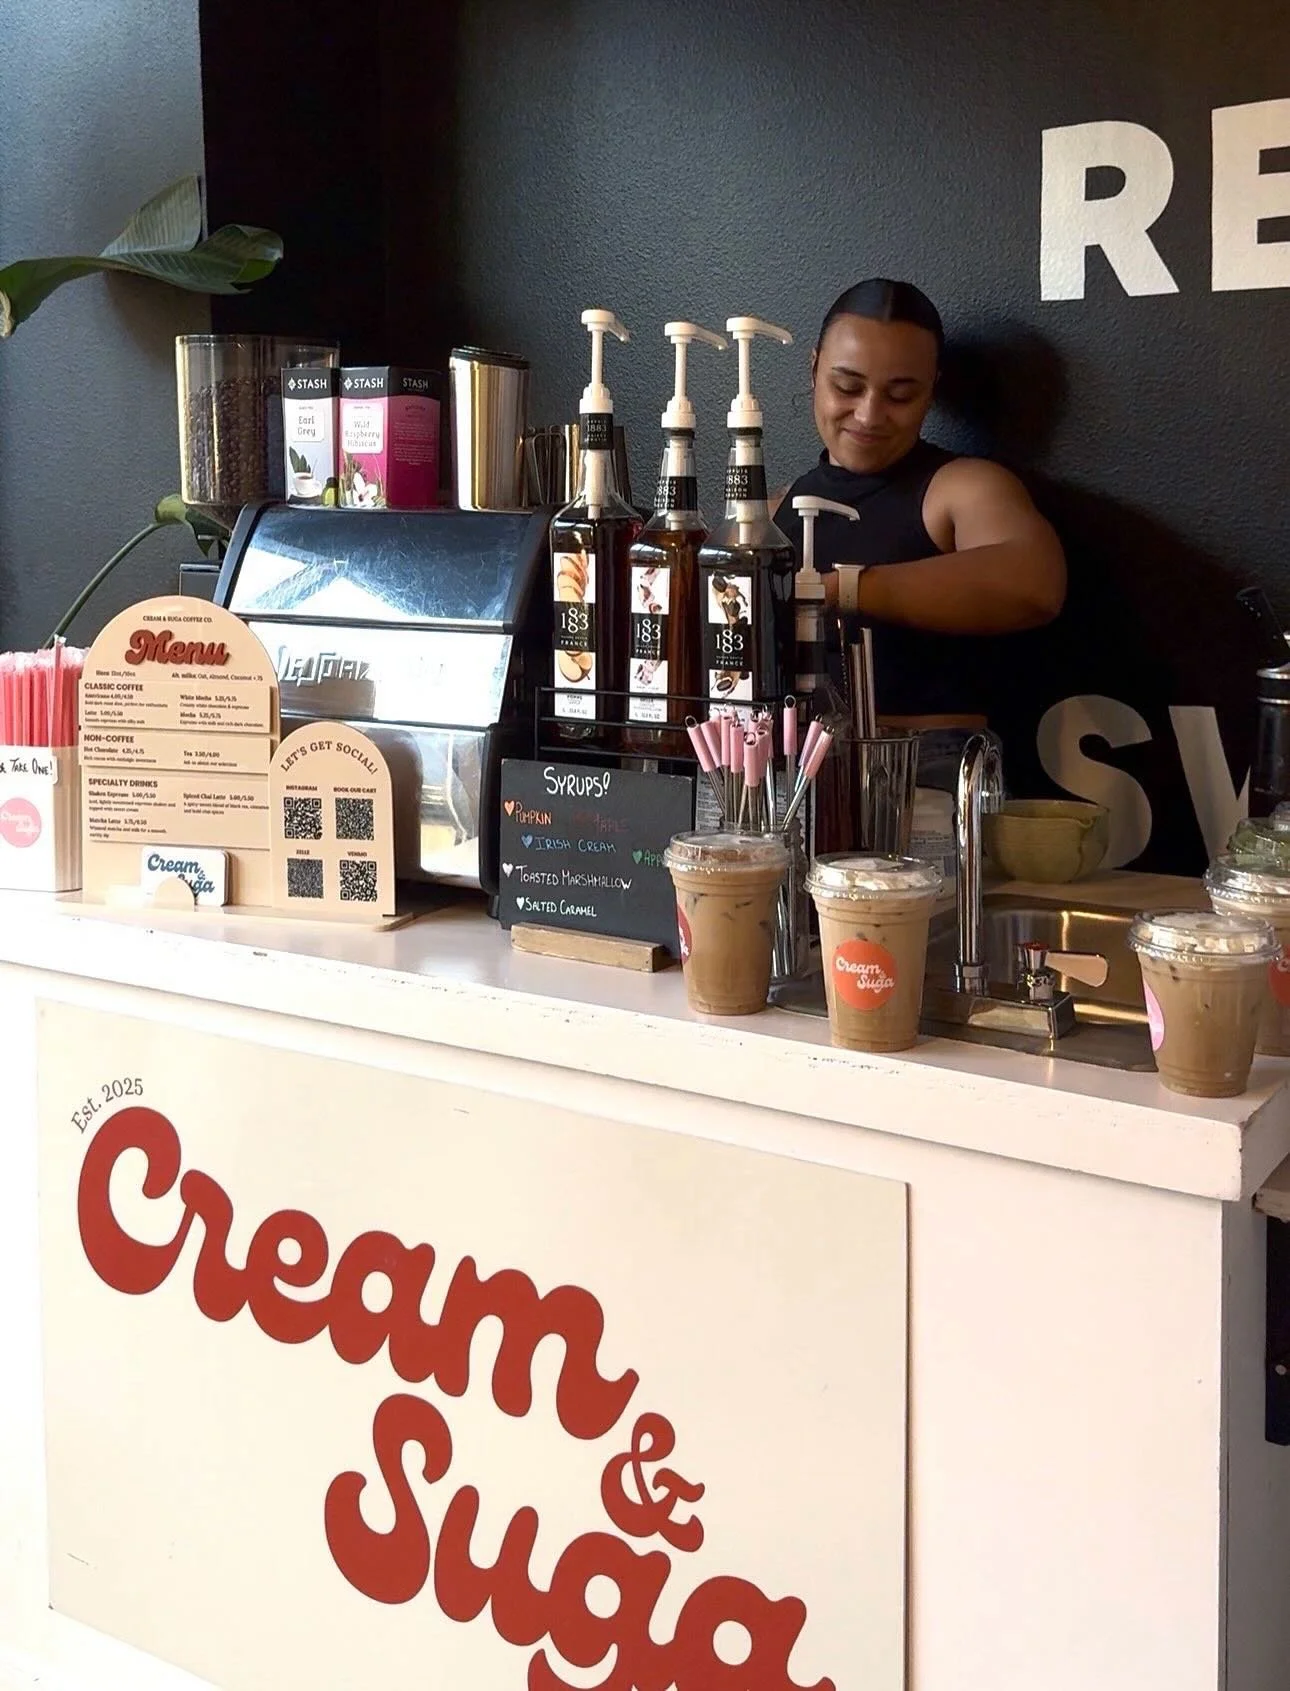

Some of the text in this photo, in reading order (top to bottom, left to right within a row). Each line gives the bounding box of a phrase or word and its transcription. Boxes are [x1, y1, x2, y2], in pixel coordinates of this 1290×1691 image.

[297, 379, 327, 389] STASH
[354, 378, 384, 389] STASH
[402, 378, 428, 389] STASH
[299, 416, 315, 424] Earl
[587, 424, 607, 432] 1883
[297, 428, 316, 437] Grey
[125, 629, 230, 666] Menu
[84, 682, 143, 691] CLASSIC COFFEE
[84, 734, 134, 743] NON-COFFEE
[280, 741, 378, 775] LET'S GET SOCIAL!
[88, 778, 158, 788] SPECIALTY DRINKS
[544, 766, 610, 798] SYRUPS!
[515, 801, 552, 825] PUMPKIN
[534, 836, 617, 853] IRISH CREAM
[147, 854, 201, 874] Cream
[644, 850, 663, 866] APP
[515, 865, 632, 890] TOASTED MARSHMALLOW
[525, 897, 597, 917] SALTED CARAMEL
[836, 956, 881, 974] Cream
[857, 974, 895, 994] Suga
[70, 1078, 143, 1134] Est. 2025
[77, 1106, 705, 1553] Cream &
[324, 1393, 836, 1691] Suga
